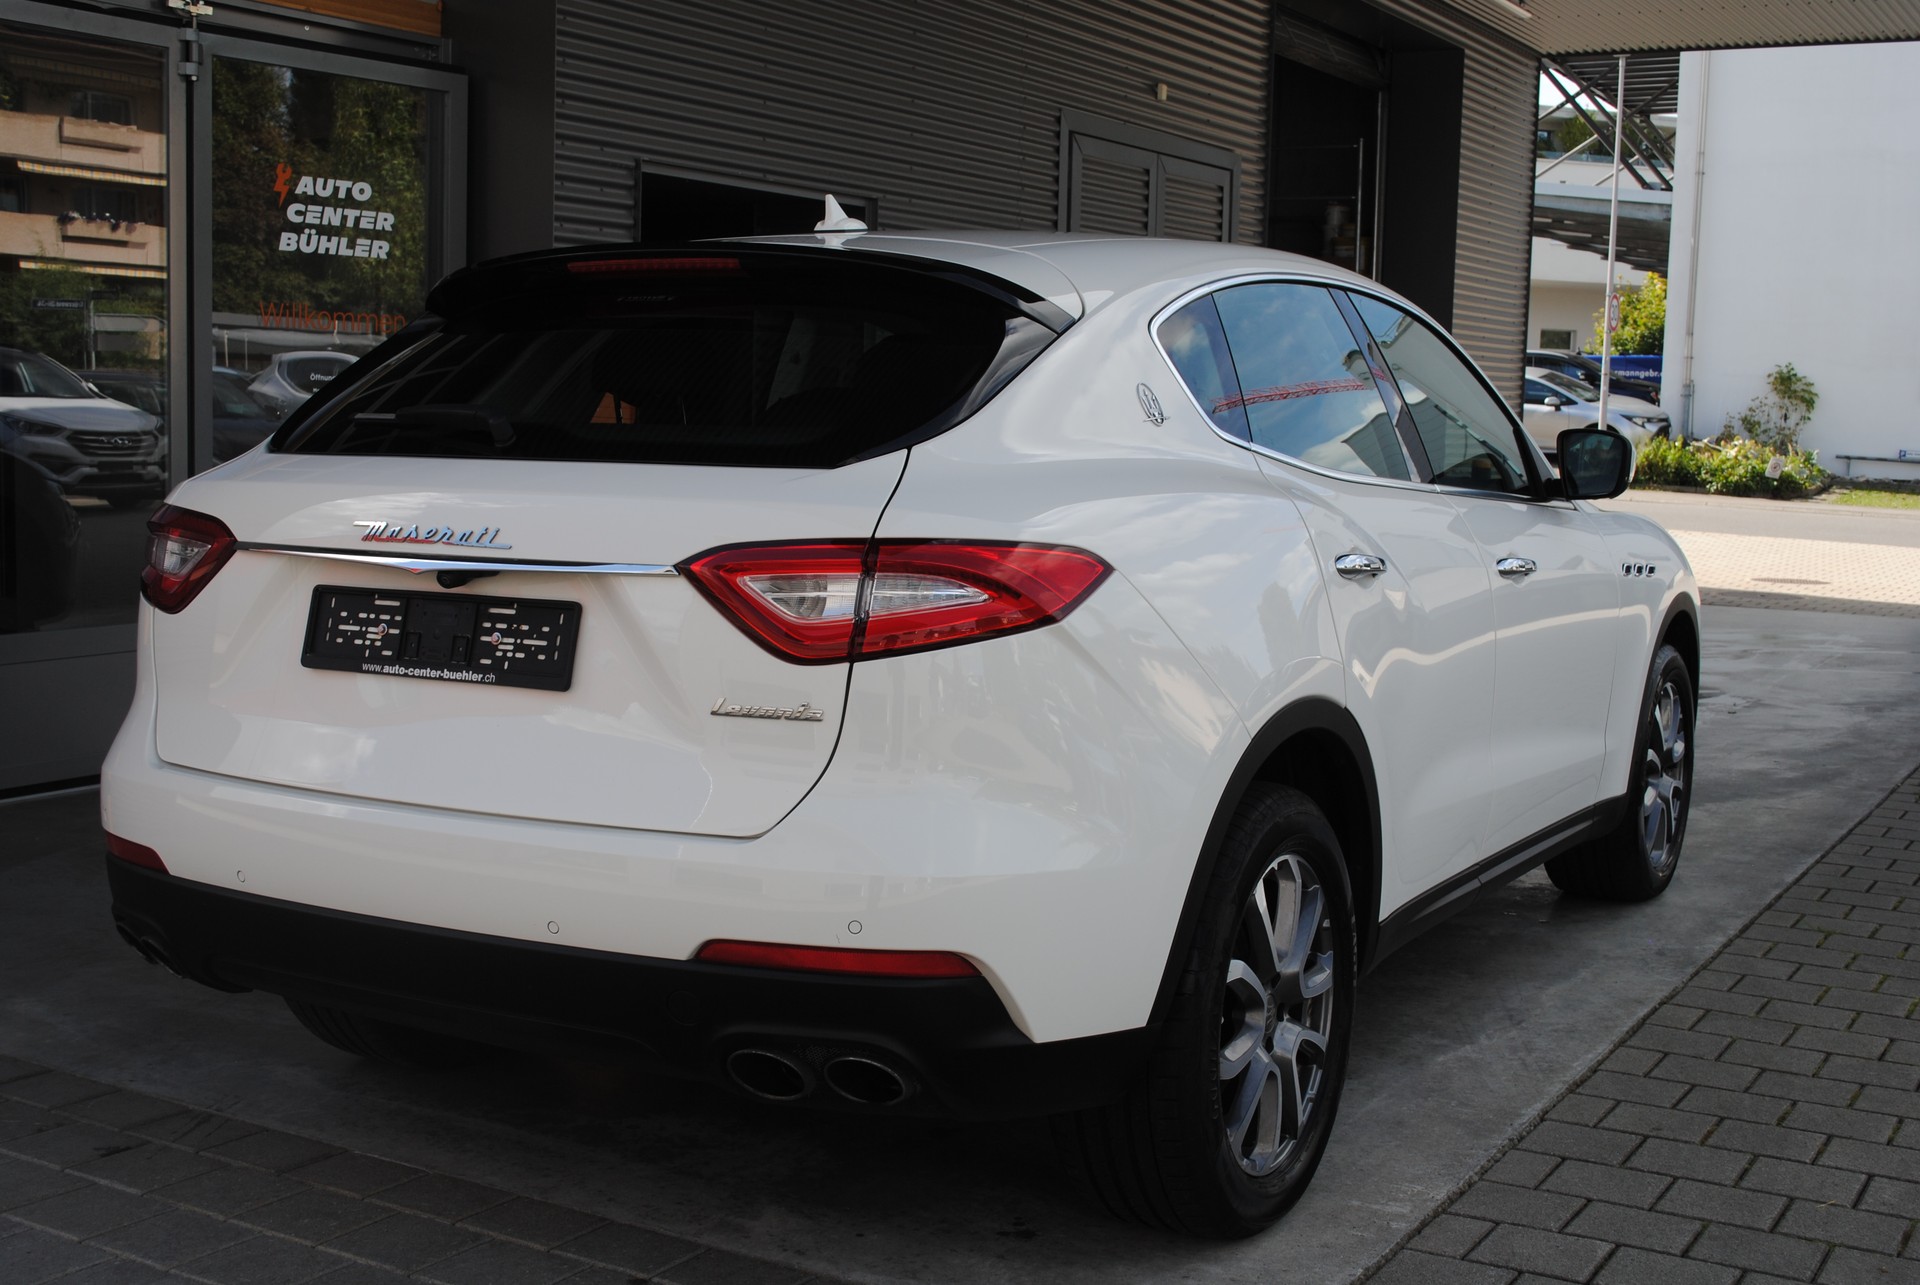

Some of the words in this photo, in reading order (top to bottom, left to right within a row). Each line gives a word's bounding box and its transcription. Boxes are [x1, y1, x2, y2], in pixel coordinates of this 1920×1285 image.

[295, 175, 373, 202] AUTO
[286, 203, 395, 232] CENTER
[278, 228, 390, 260] BÜHLER
[259, 301, 406, 334] Willkommen
[353, 520, 513, 550] Maserati
[362, 662, 496, 683] www.auto-center-buehler.ch
